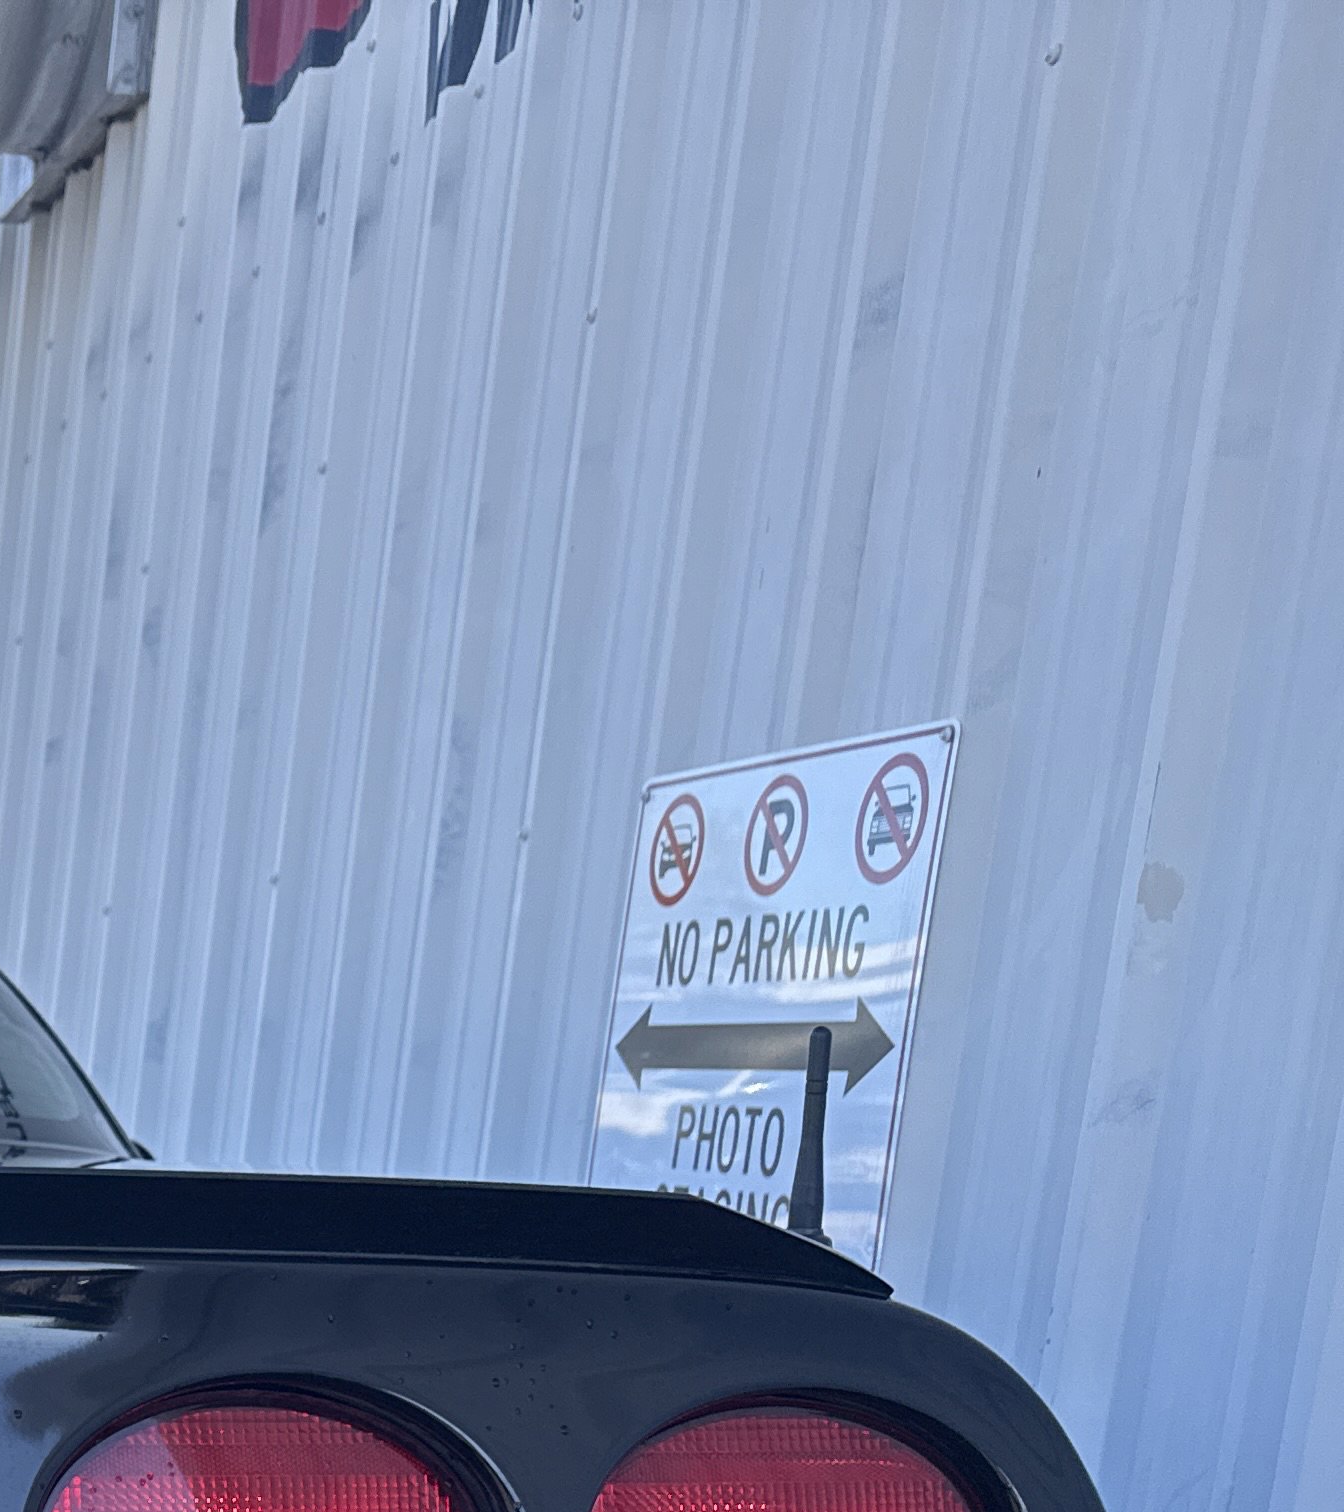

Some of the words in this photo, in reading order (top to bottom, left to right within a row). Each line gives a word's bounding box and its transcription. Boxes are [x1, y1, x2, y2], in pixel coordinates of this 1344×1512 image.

[656, 919, 700, 987] NO
[707, 904, 870, 985] PARKING
[671, 1105, 785, 1177] PHOTO
